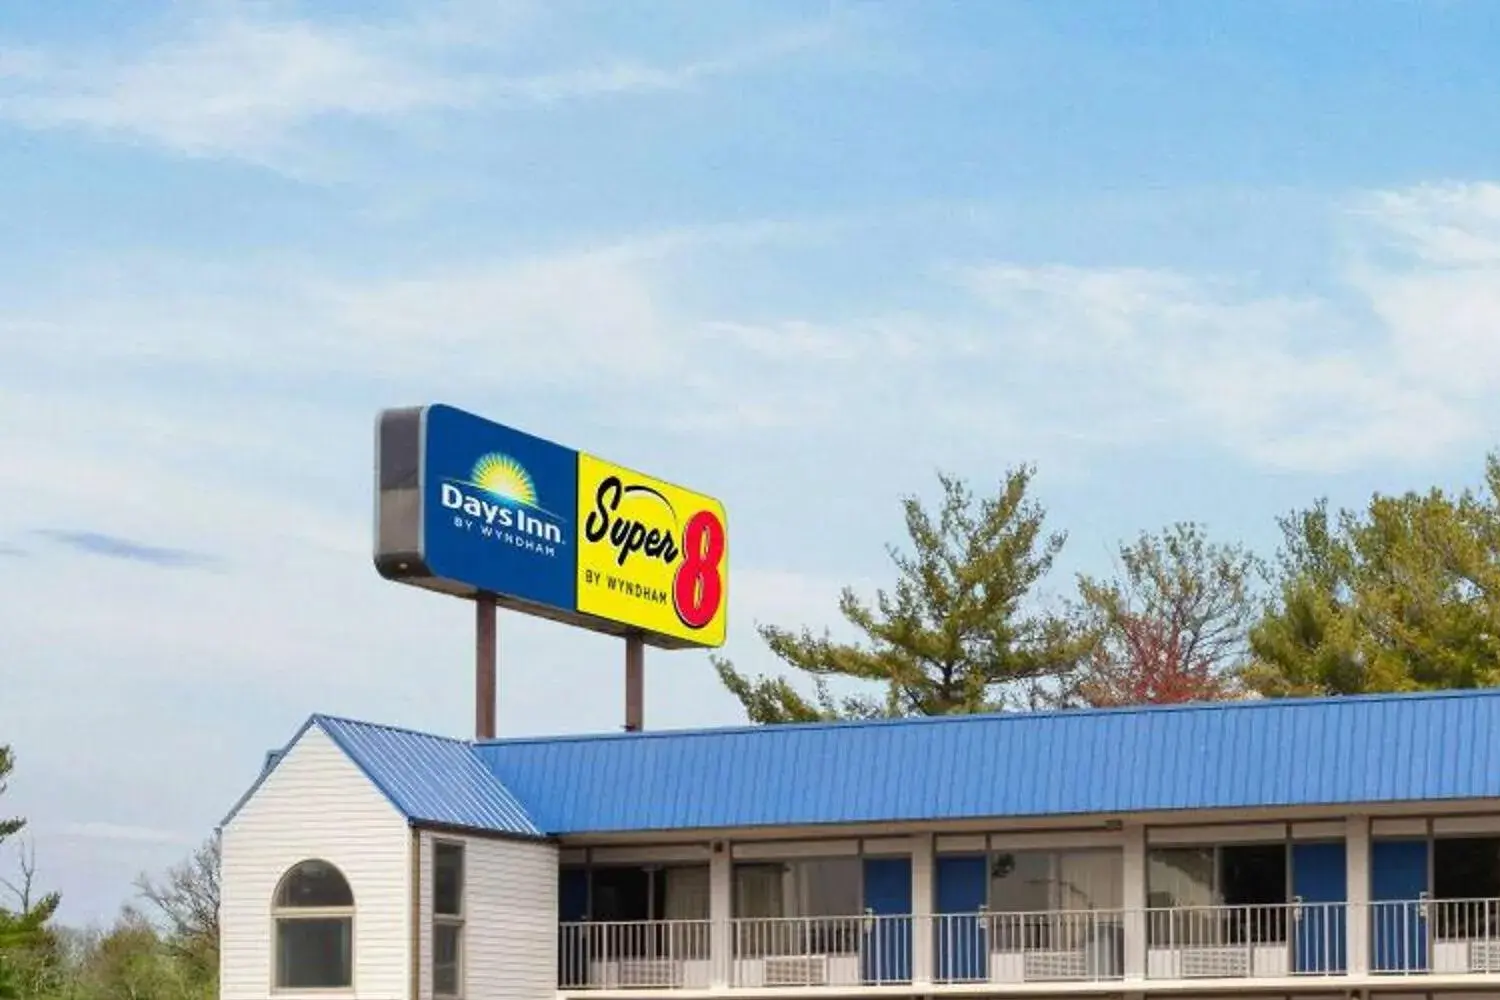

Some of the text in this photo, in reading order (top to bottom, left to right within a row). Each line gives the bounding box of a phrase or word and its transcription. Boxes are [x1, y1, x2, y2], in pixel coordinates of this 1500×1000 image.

[441, 483, 561, 543] Days Inn
[453, 515, 556, 557] BY WYNDHAM
[585, 475, 725, 630] Super 8
[585, 569, 668, 605] BY WYNDHAM
